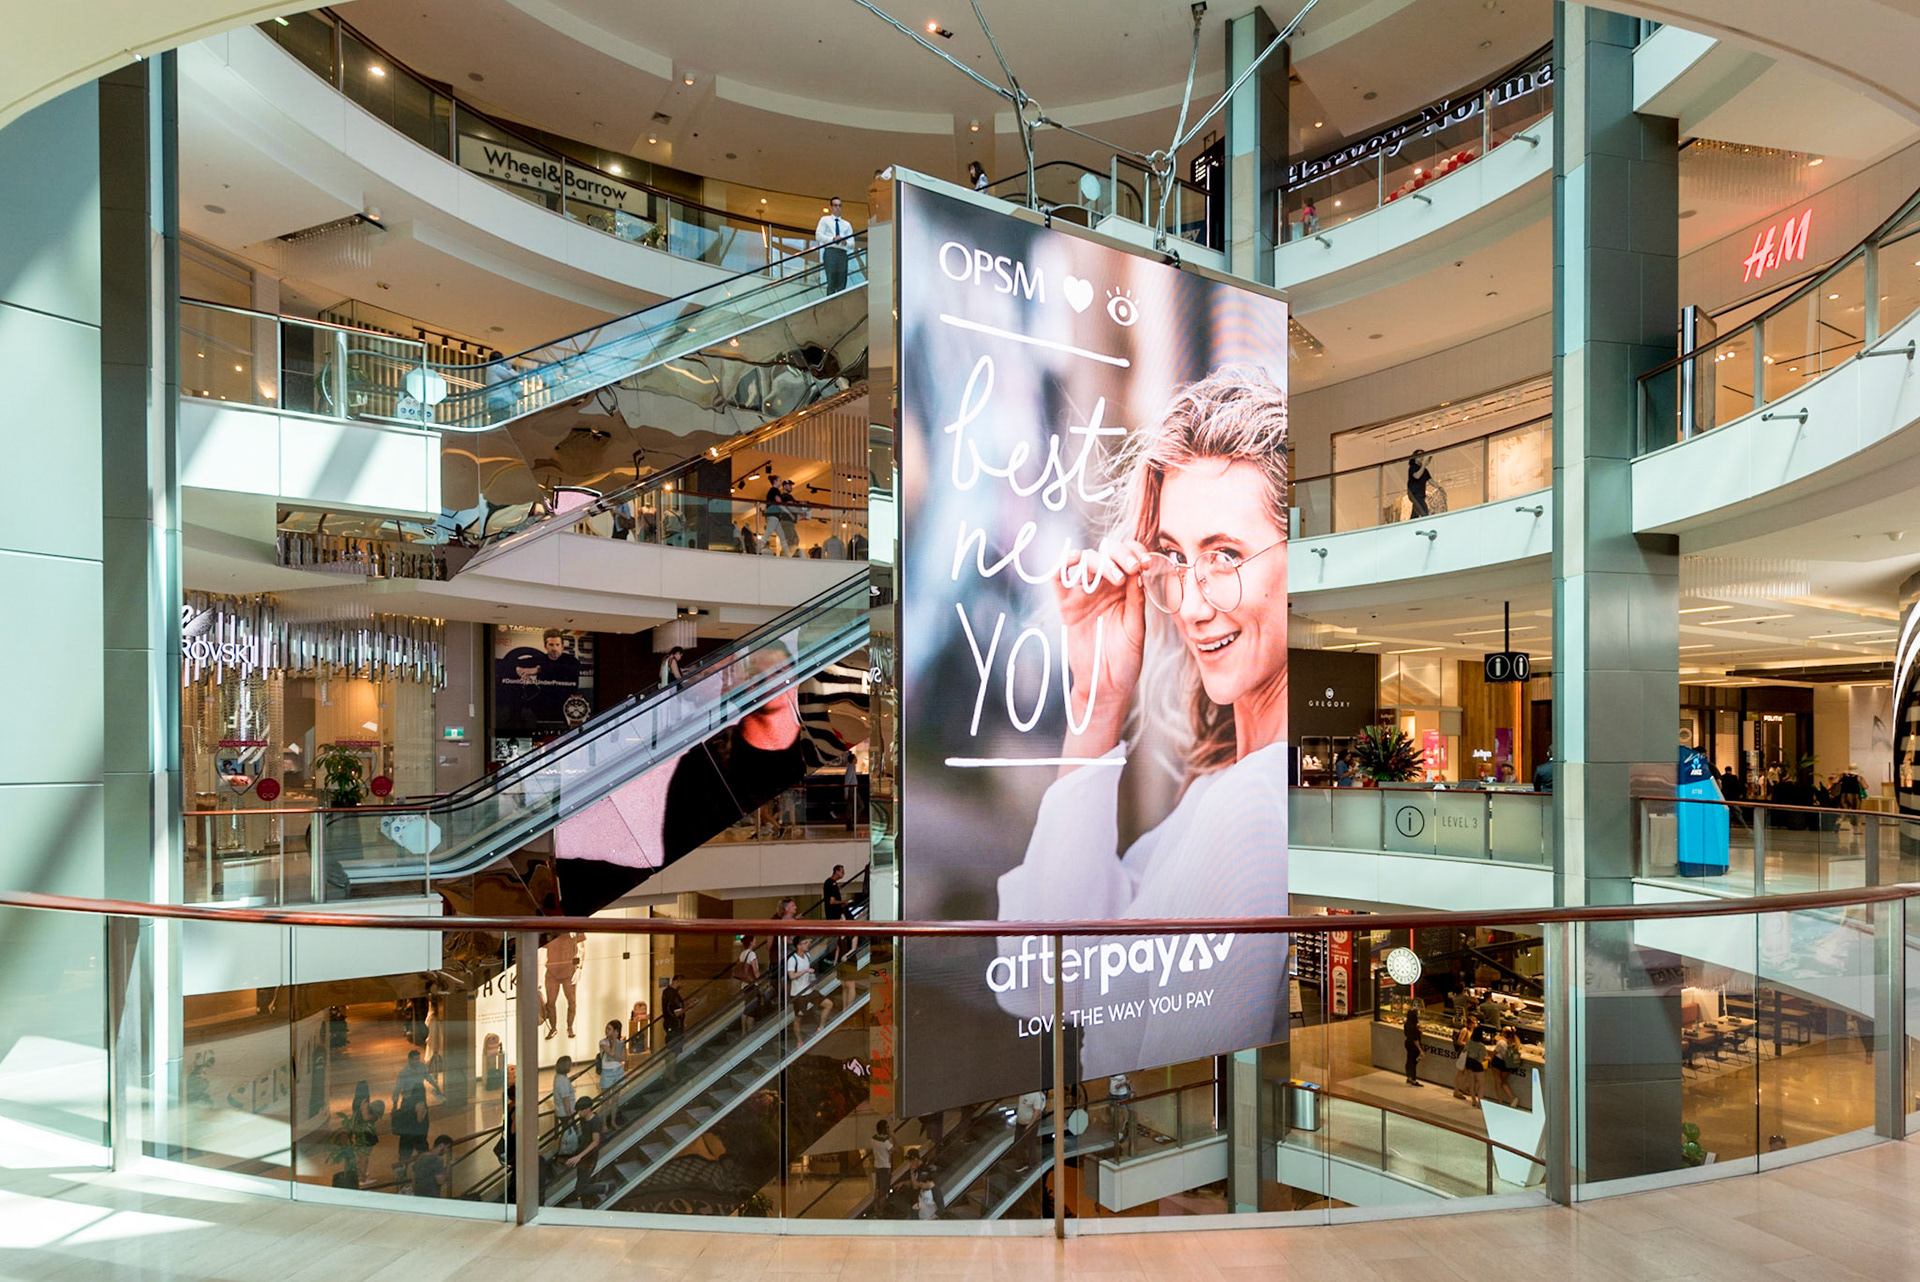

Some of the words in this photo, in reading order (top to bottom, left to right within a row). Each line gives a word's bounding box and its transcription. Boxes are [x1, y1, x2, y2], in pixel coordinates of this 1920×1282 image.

[483, 146, 627, 200] Wheel&Barrow
[1289, 125, 1409, 192] Harvey
[489, 168, 623, 209] HOMEWARES
[939, 241, 1046, 303] OPSM
[1743, 208, 1812, 283] H&M
[945, 354, 1128, 511] best
[951, 520, 1109, 594] new
[955, 602, 1105, 737] YOU
[1308, 700, 1350, 708] GREGORY
[1442, 815, 1468, 828] LEVEL
[1473, 817, 1478, 829] 3
[985, 934, 1180, 996] afterpay
[1333, 954, 1349, 965] FIT
[1018, 1012, 1066, 1038] LOV
[1070, 1006, 1104, 1029] THE
[1107, 999, 1146, 1023] WAY
[1148, 991, 1183, 1016] YOU
[1185, 988, 1215, 1009] PAY
[1420, 1041, 1459, 1060] PRESS
